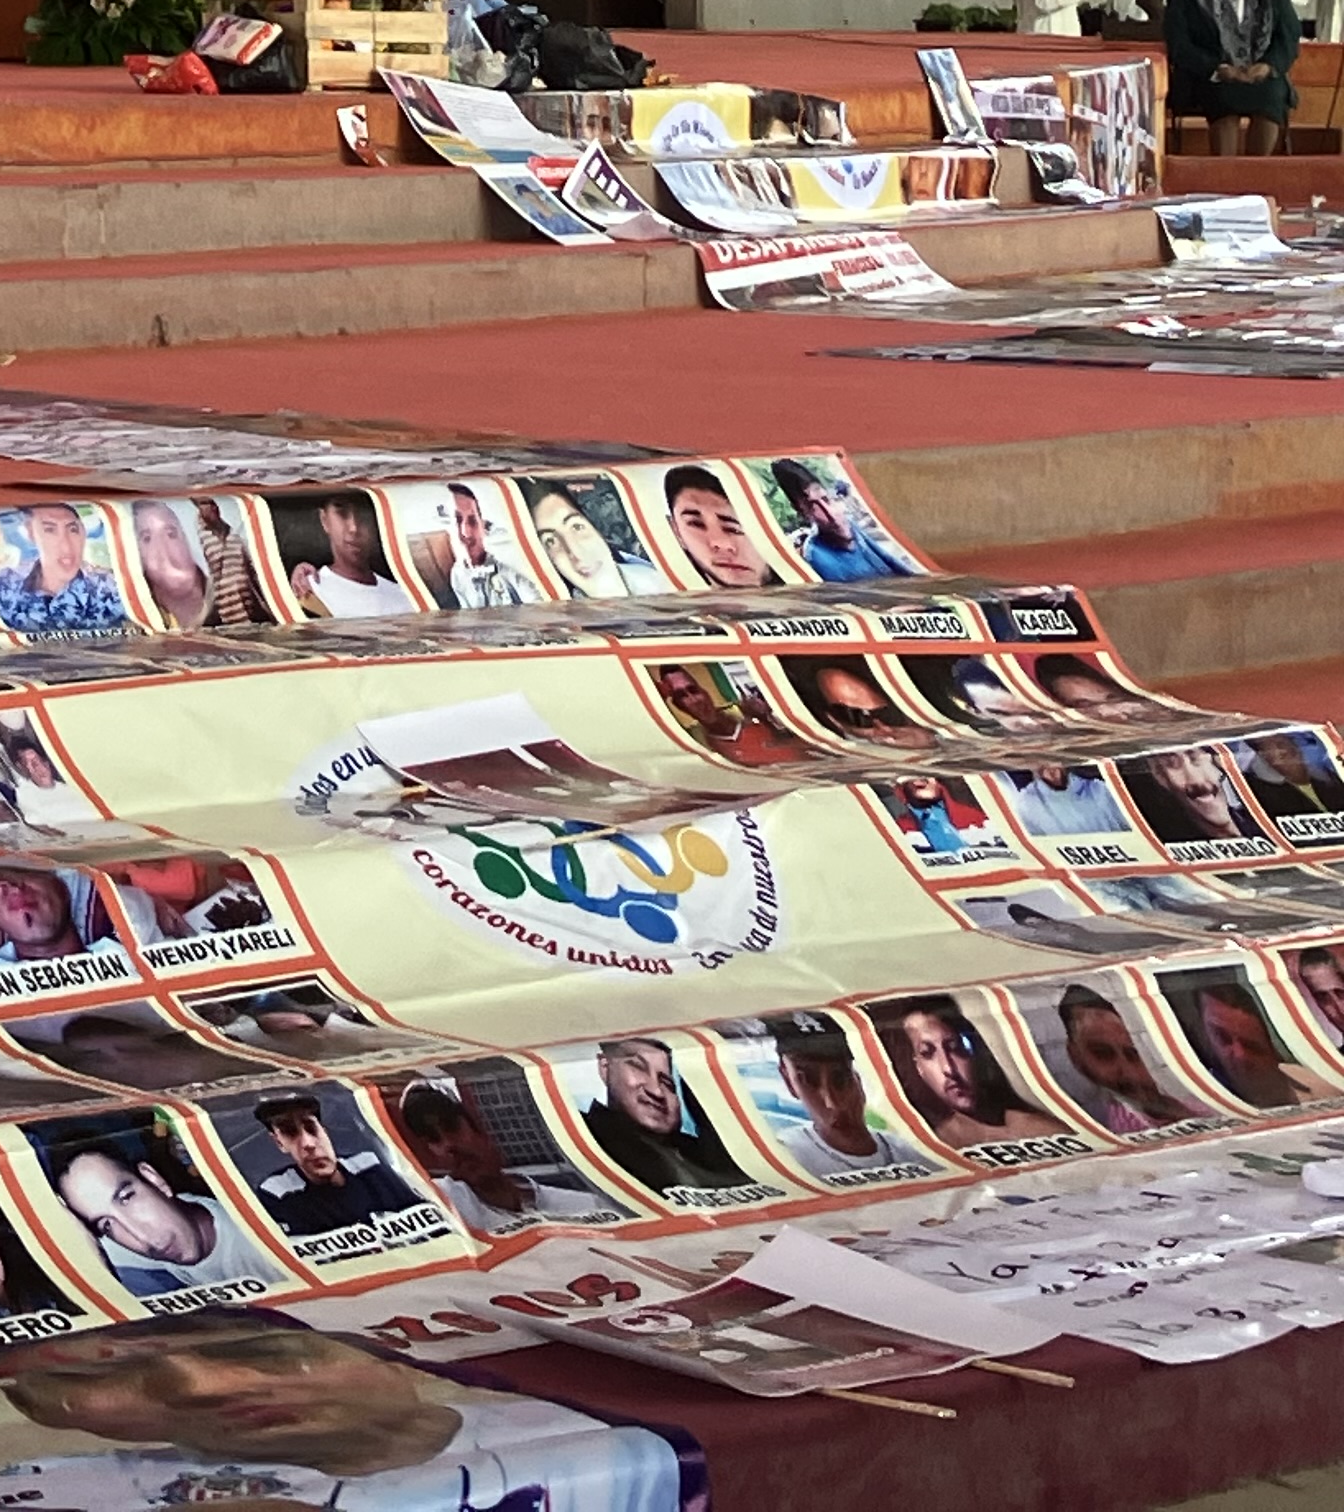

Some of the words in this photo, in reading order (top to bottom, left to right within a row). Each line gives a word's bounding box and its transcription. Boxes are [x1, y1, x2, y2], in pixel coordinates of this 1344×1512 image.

[746, 617, 850, 638] ALEJANDRO
[879, 614, 962, 636] MAURICIO
[1016, 612, 1072, 632] KARLA
[1056, 845, 1139, 865] ISRAEL
[1169, 844, 1216, 864] JUAN
[1218, 837, 1277, 860] PABLO
[412, 848, 559, 956] corazones
[566, 946, 674, 976] unidos
[141, 938, 221, 970] WENDY
[223, 927, 297, 956] YARELI
[20, 954, 130, 993] SEBASTIAN
[963, 1136, 1095, 1172] SERGIO
[293, 1226, 376, 1261] ARTURO
[147, 1278, 266, 1316] ERNESTO
